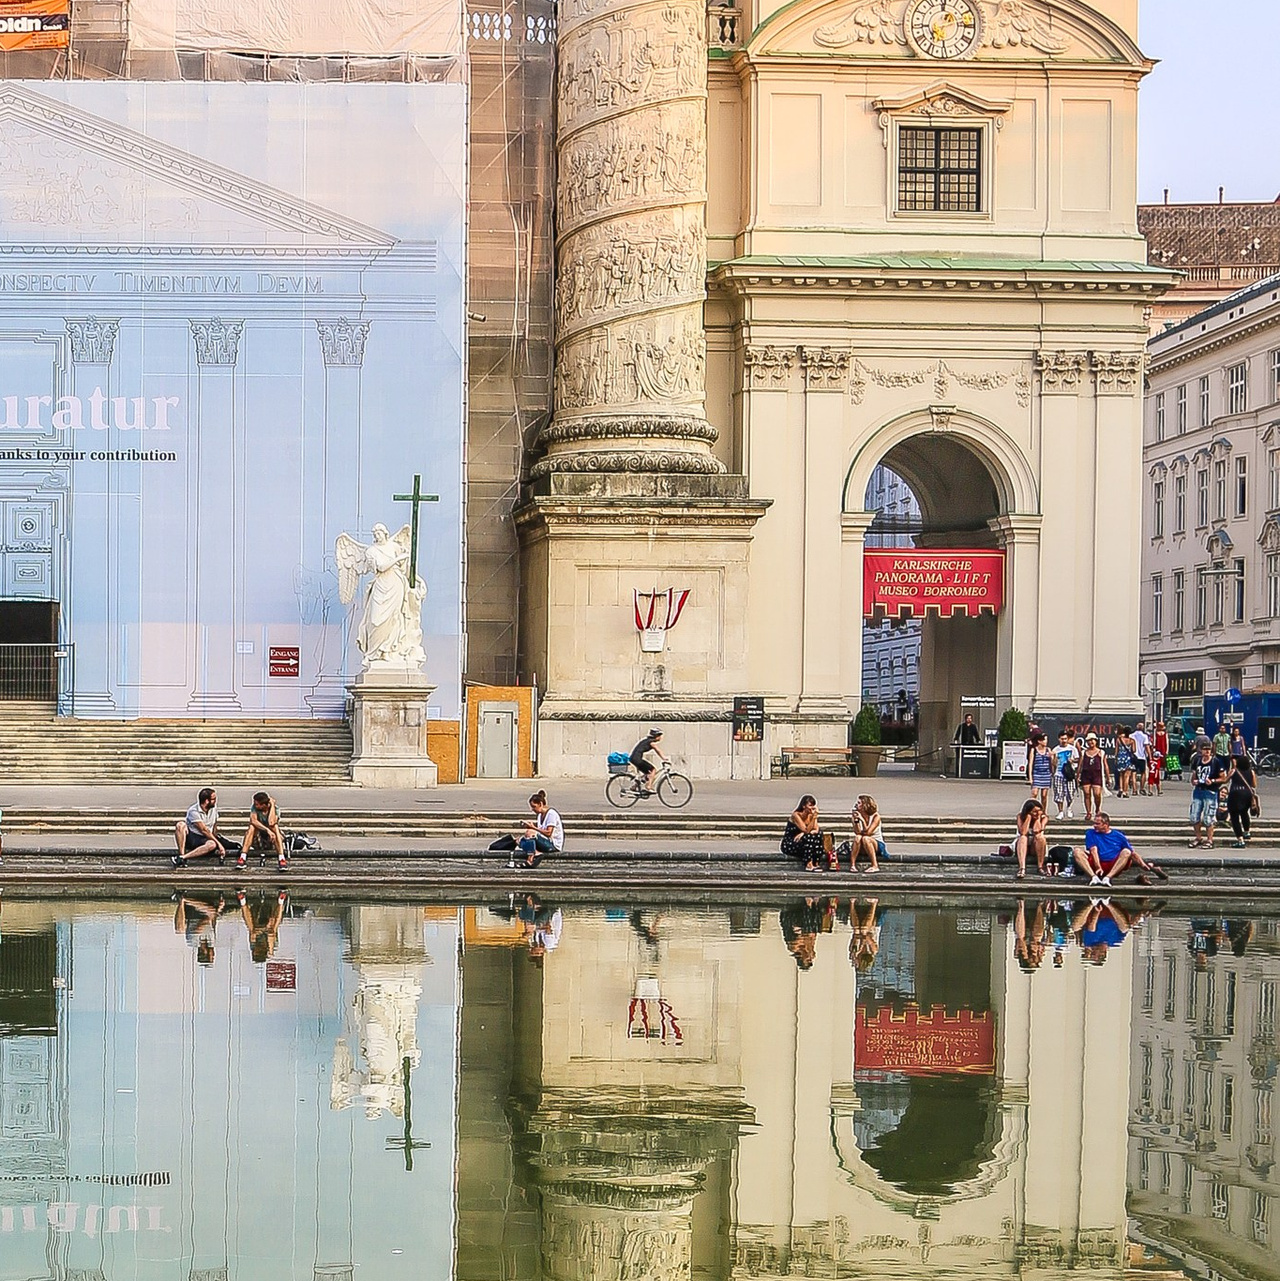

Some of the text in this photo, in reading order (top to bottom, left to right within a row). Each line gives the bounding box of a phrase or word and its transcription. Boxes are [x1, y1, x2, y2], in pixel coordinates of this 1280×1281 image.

[36, 449, 50, 461] to
[54, 451, 86, 464] your
[90, 449, 177, 462] contribution
[893, 560, 972, 570] KARLSKIRCHE
[875, 572, 943, 583] PANORAMA
[878, 585, 987, 596] MUSEO BORROMEO
[1064, 723, 1114, 735] MOZART
